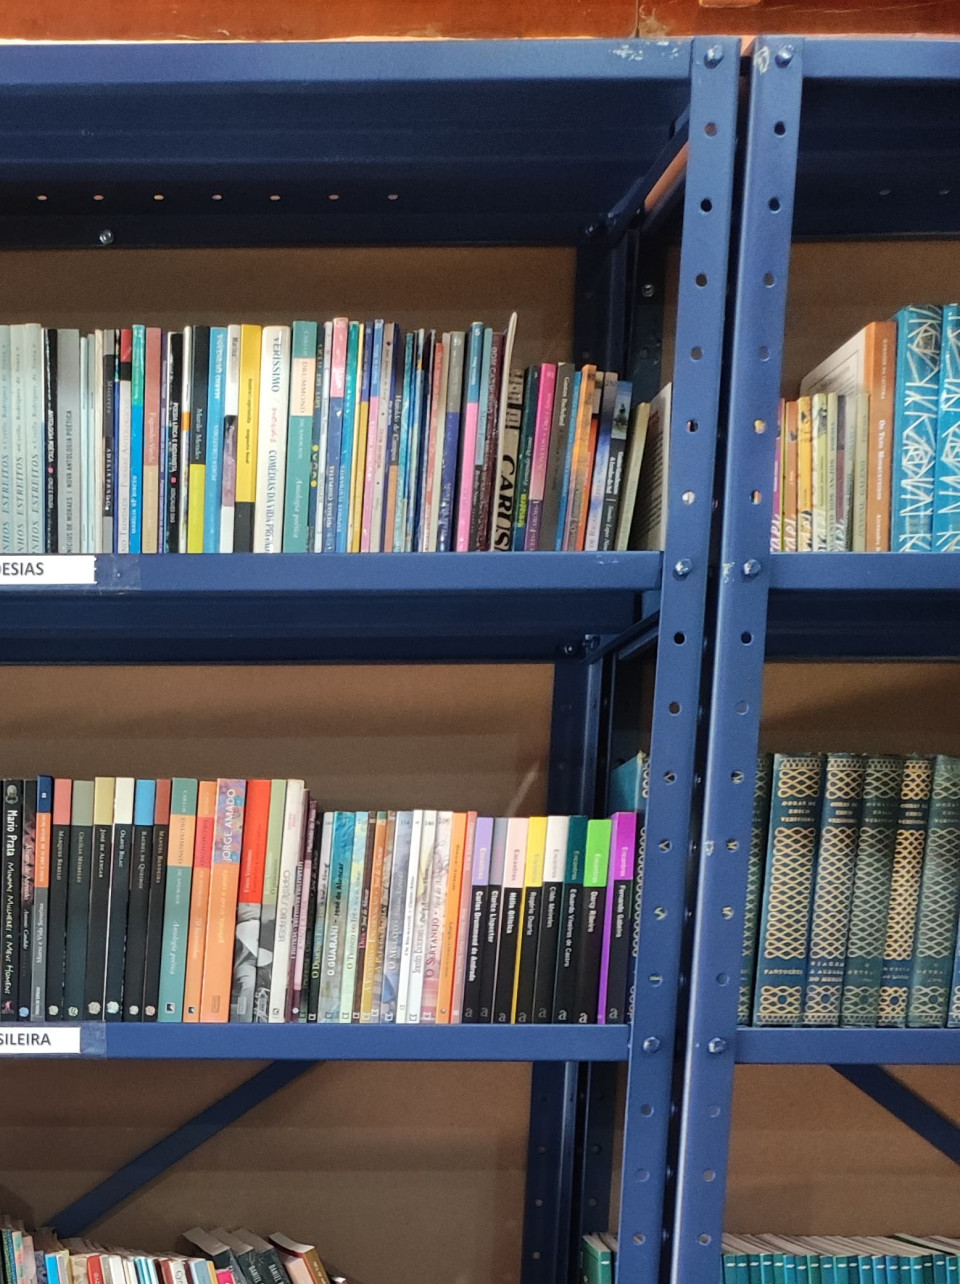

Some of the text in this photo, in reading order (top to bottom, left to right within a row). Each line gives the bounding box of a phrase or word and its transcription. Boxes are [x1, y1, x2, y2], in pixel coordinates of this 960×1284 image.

[6, 809, 17, 855] Mario Prata
[222, 789, 235, 860] JORGE AMADO
[474, 890, 483, 910] Carlos
[587, 891, 598, 932] Darcy Ribeiro
[615, 884, 626, 937] Fernando Gabeira
[471, 912, 481, 945] Drummond
[468, 955, 477, 981] Andrade
